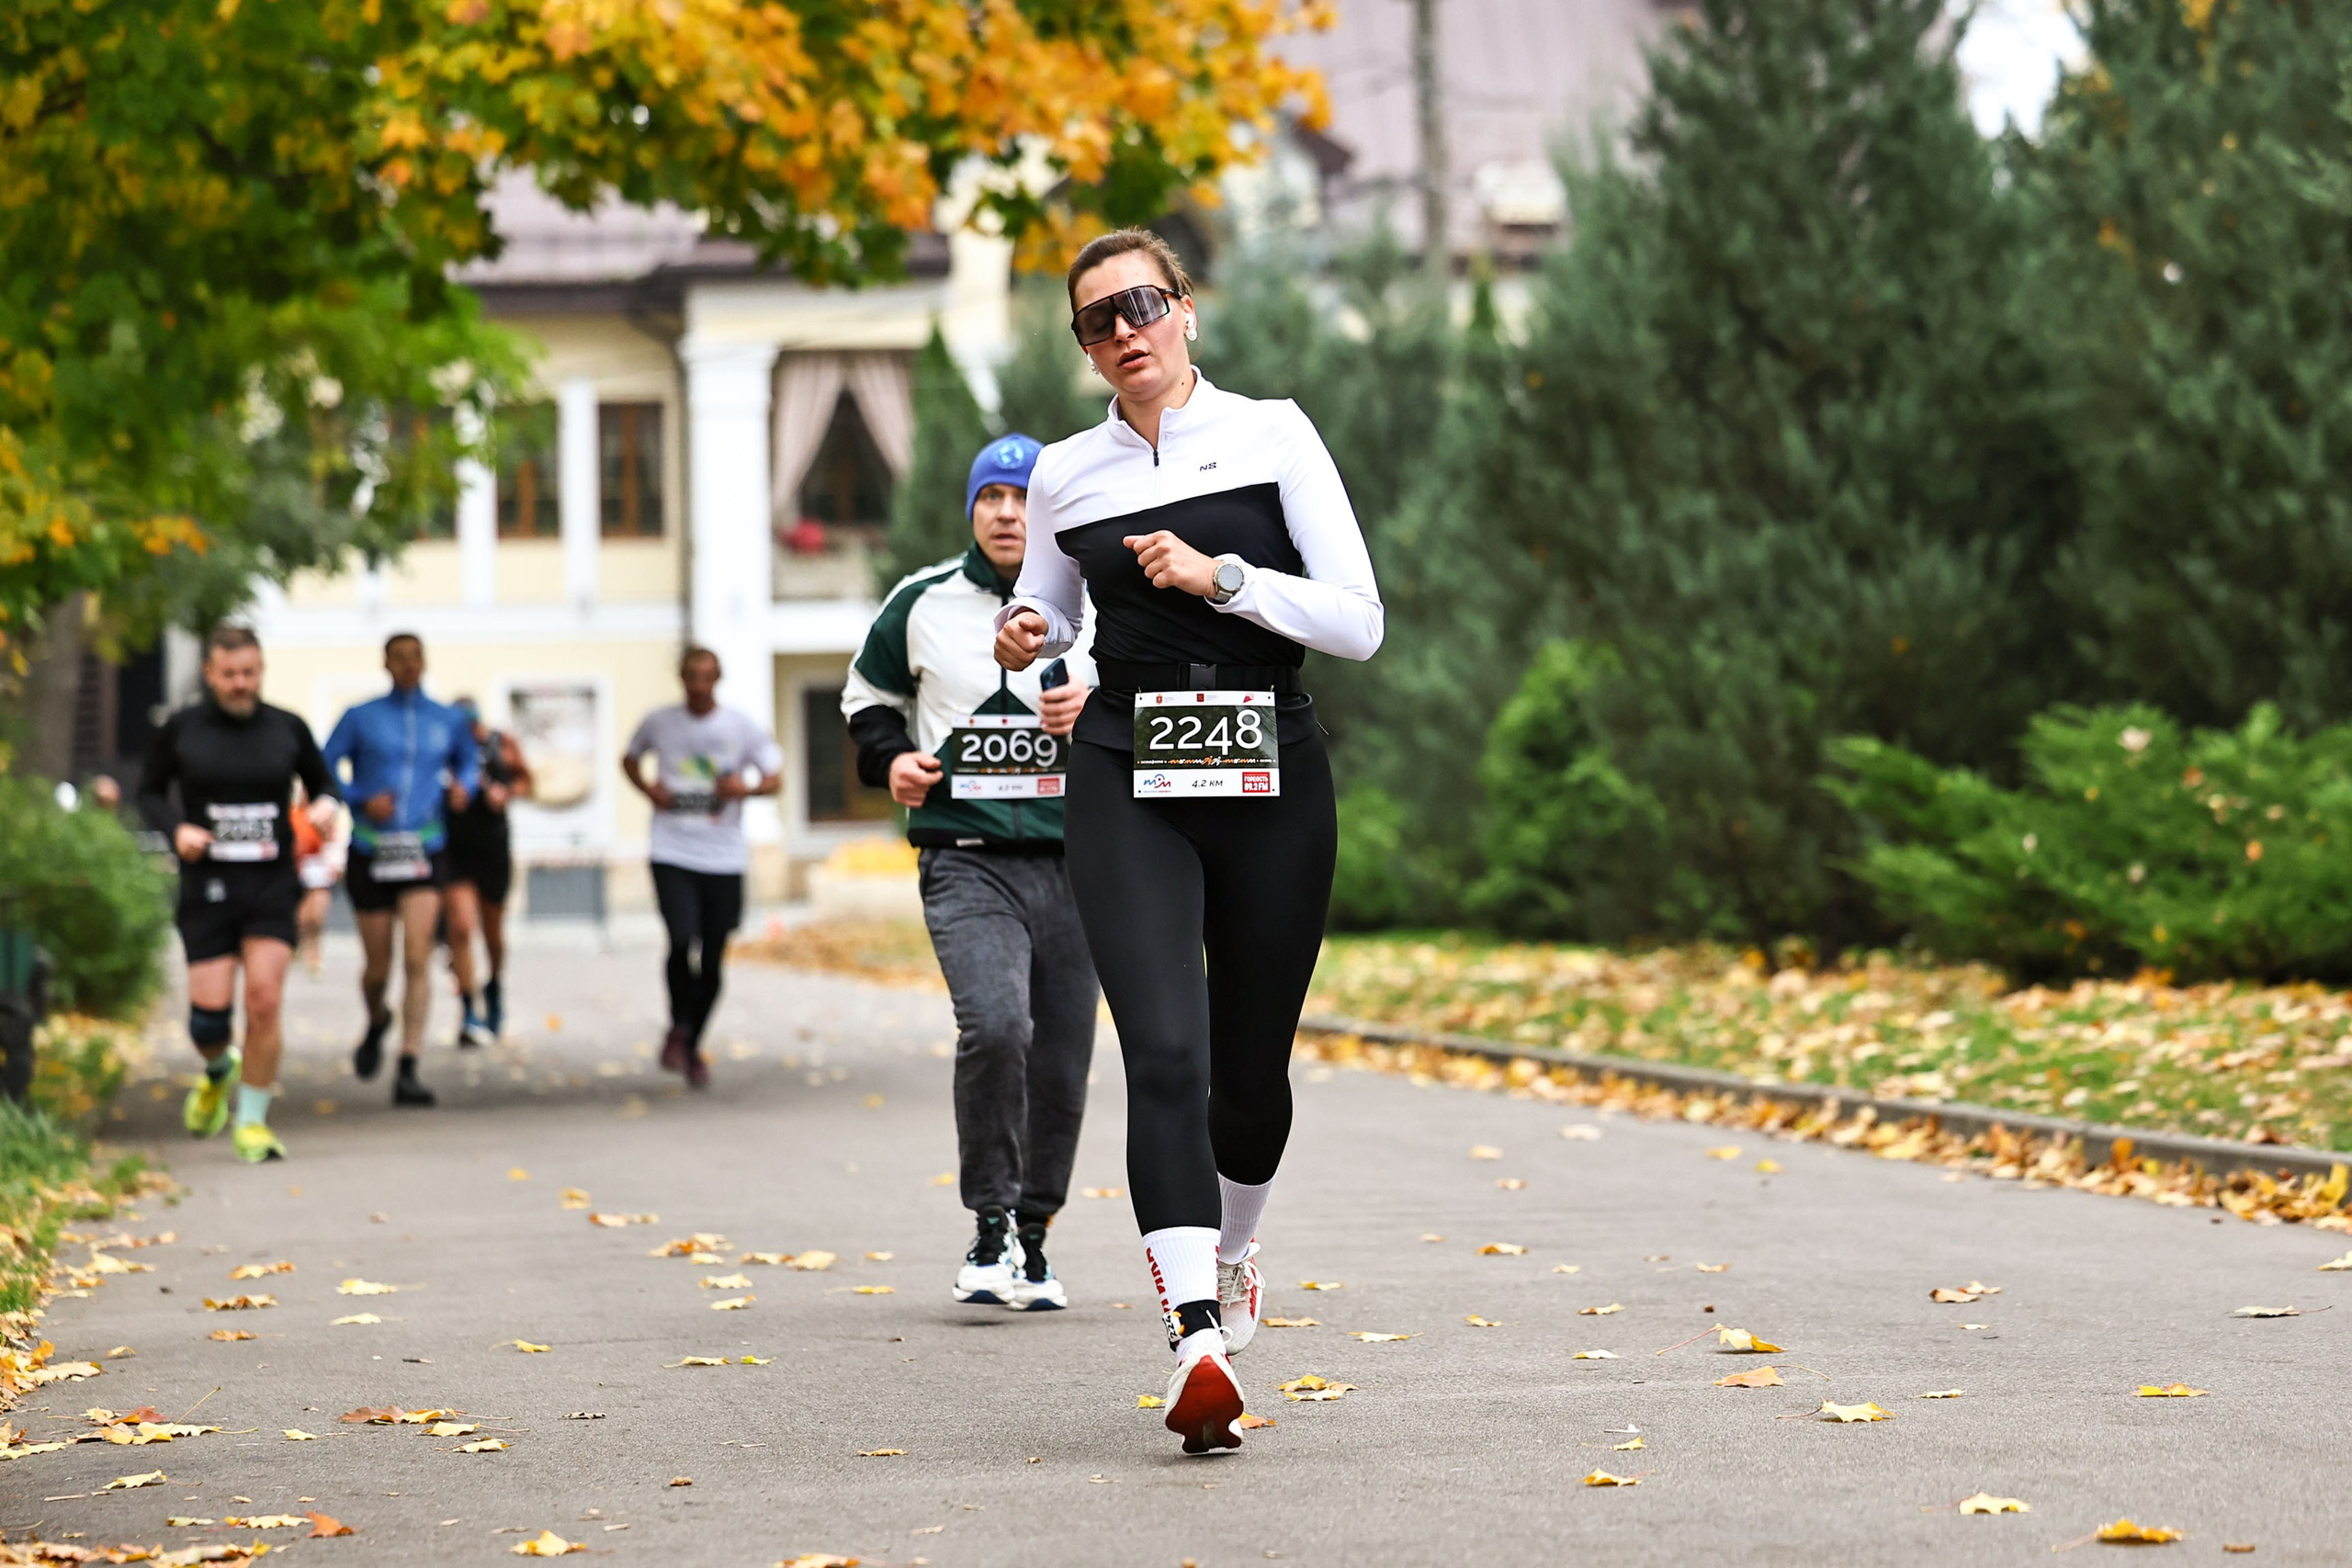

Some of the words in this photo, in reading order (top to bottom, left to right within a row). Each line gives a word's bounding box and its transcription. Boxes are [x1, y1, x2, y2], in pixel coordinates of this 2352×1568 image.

[1148, 708, 1263, 756] 2248
[960, 728, 1058, 768] 2069
[1192, 779, 1207, 788] 4.2
[1244, 783, 1258, 791] 89.2
[1258, 783, 1269, 791] FM
[1165, 1311, 1178, 1339] 224
